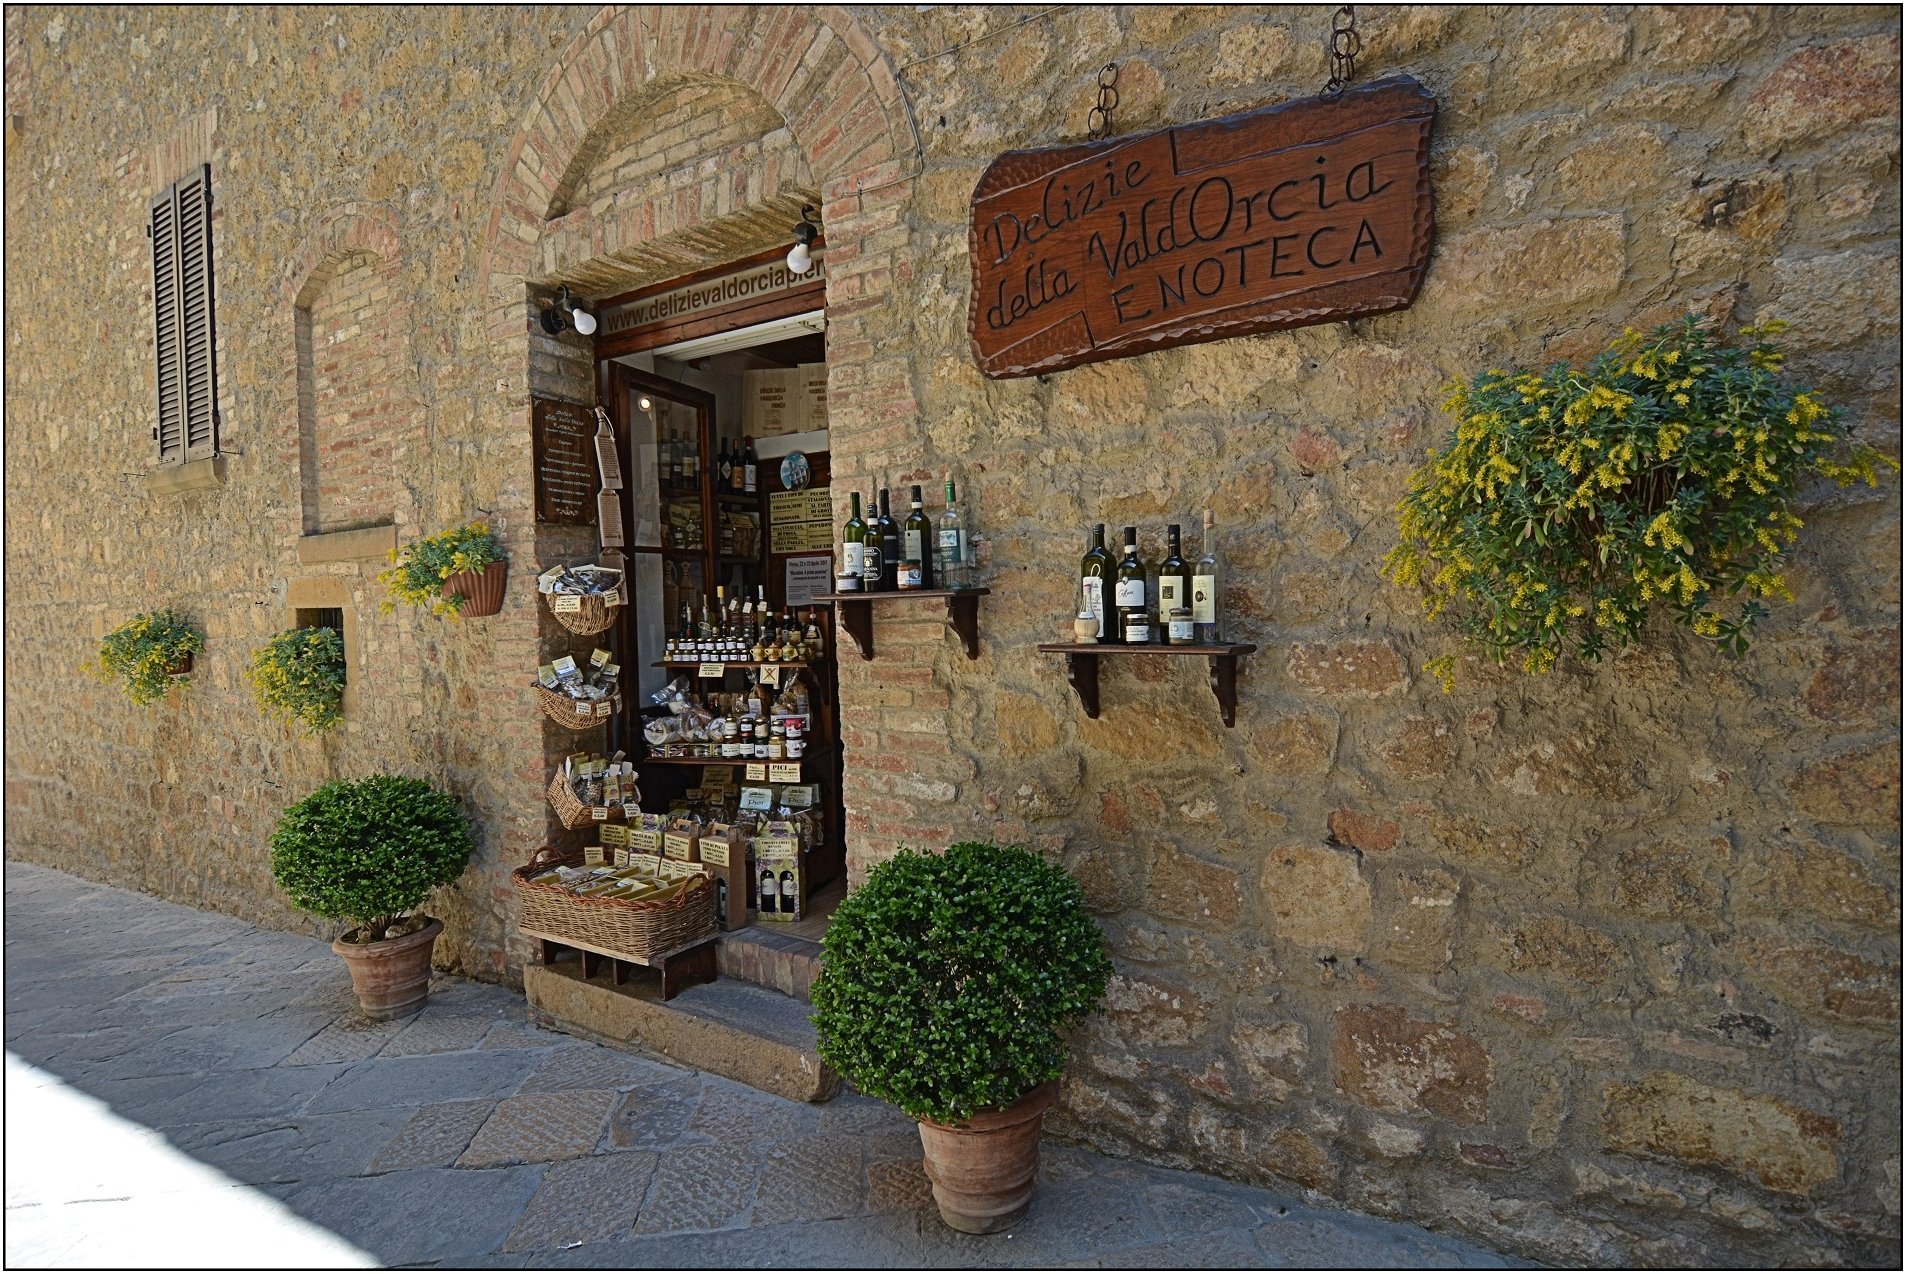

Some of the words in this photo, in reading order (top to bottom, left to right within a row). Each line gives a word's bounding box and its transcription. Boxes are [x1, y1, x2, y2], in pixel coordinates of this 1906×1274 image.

[984, 158, 1151, 265] Delizie
[986, 256, 1078, 331] della
[1111, 217, 1384, 323] ENOTECA
